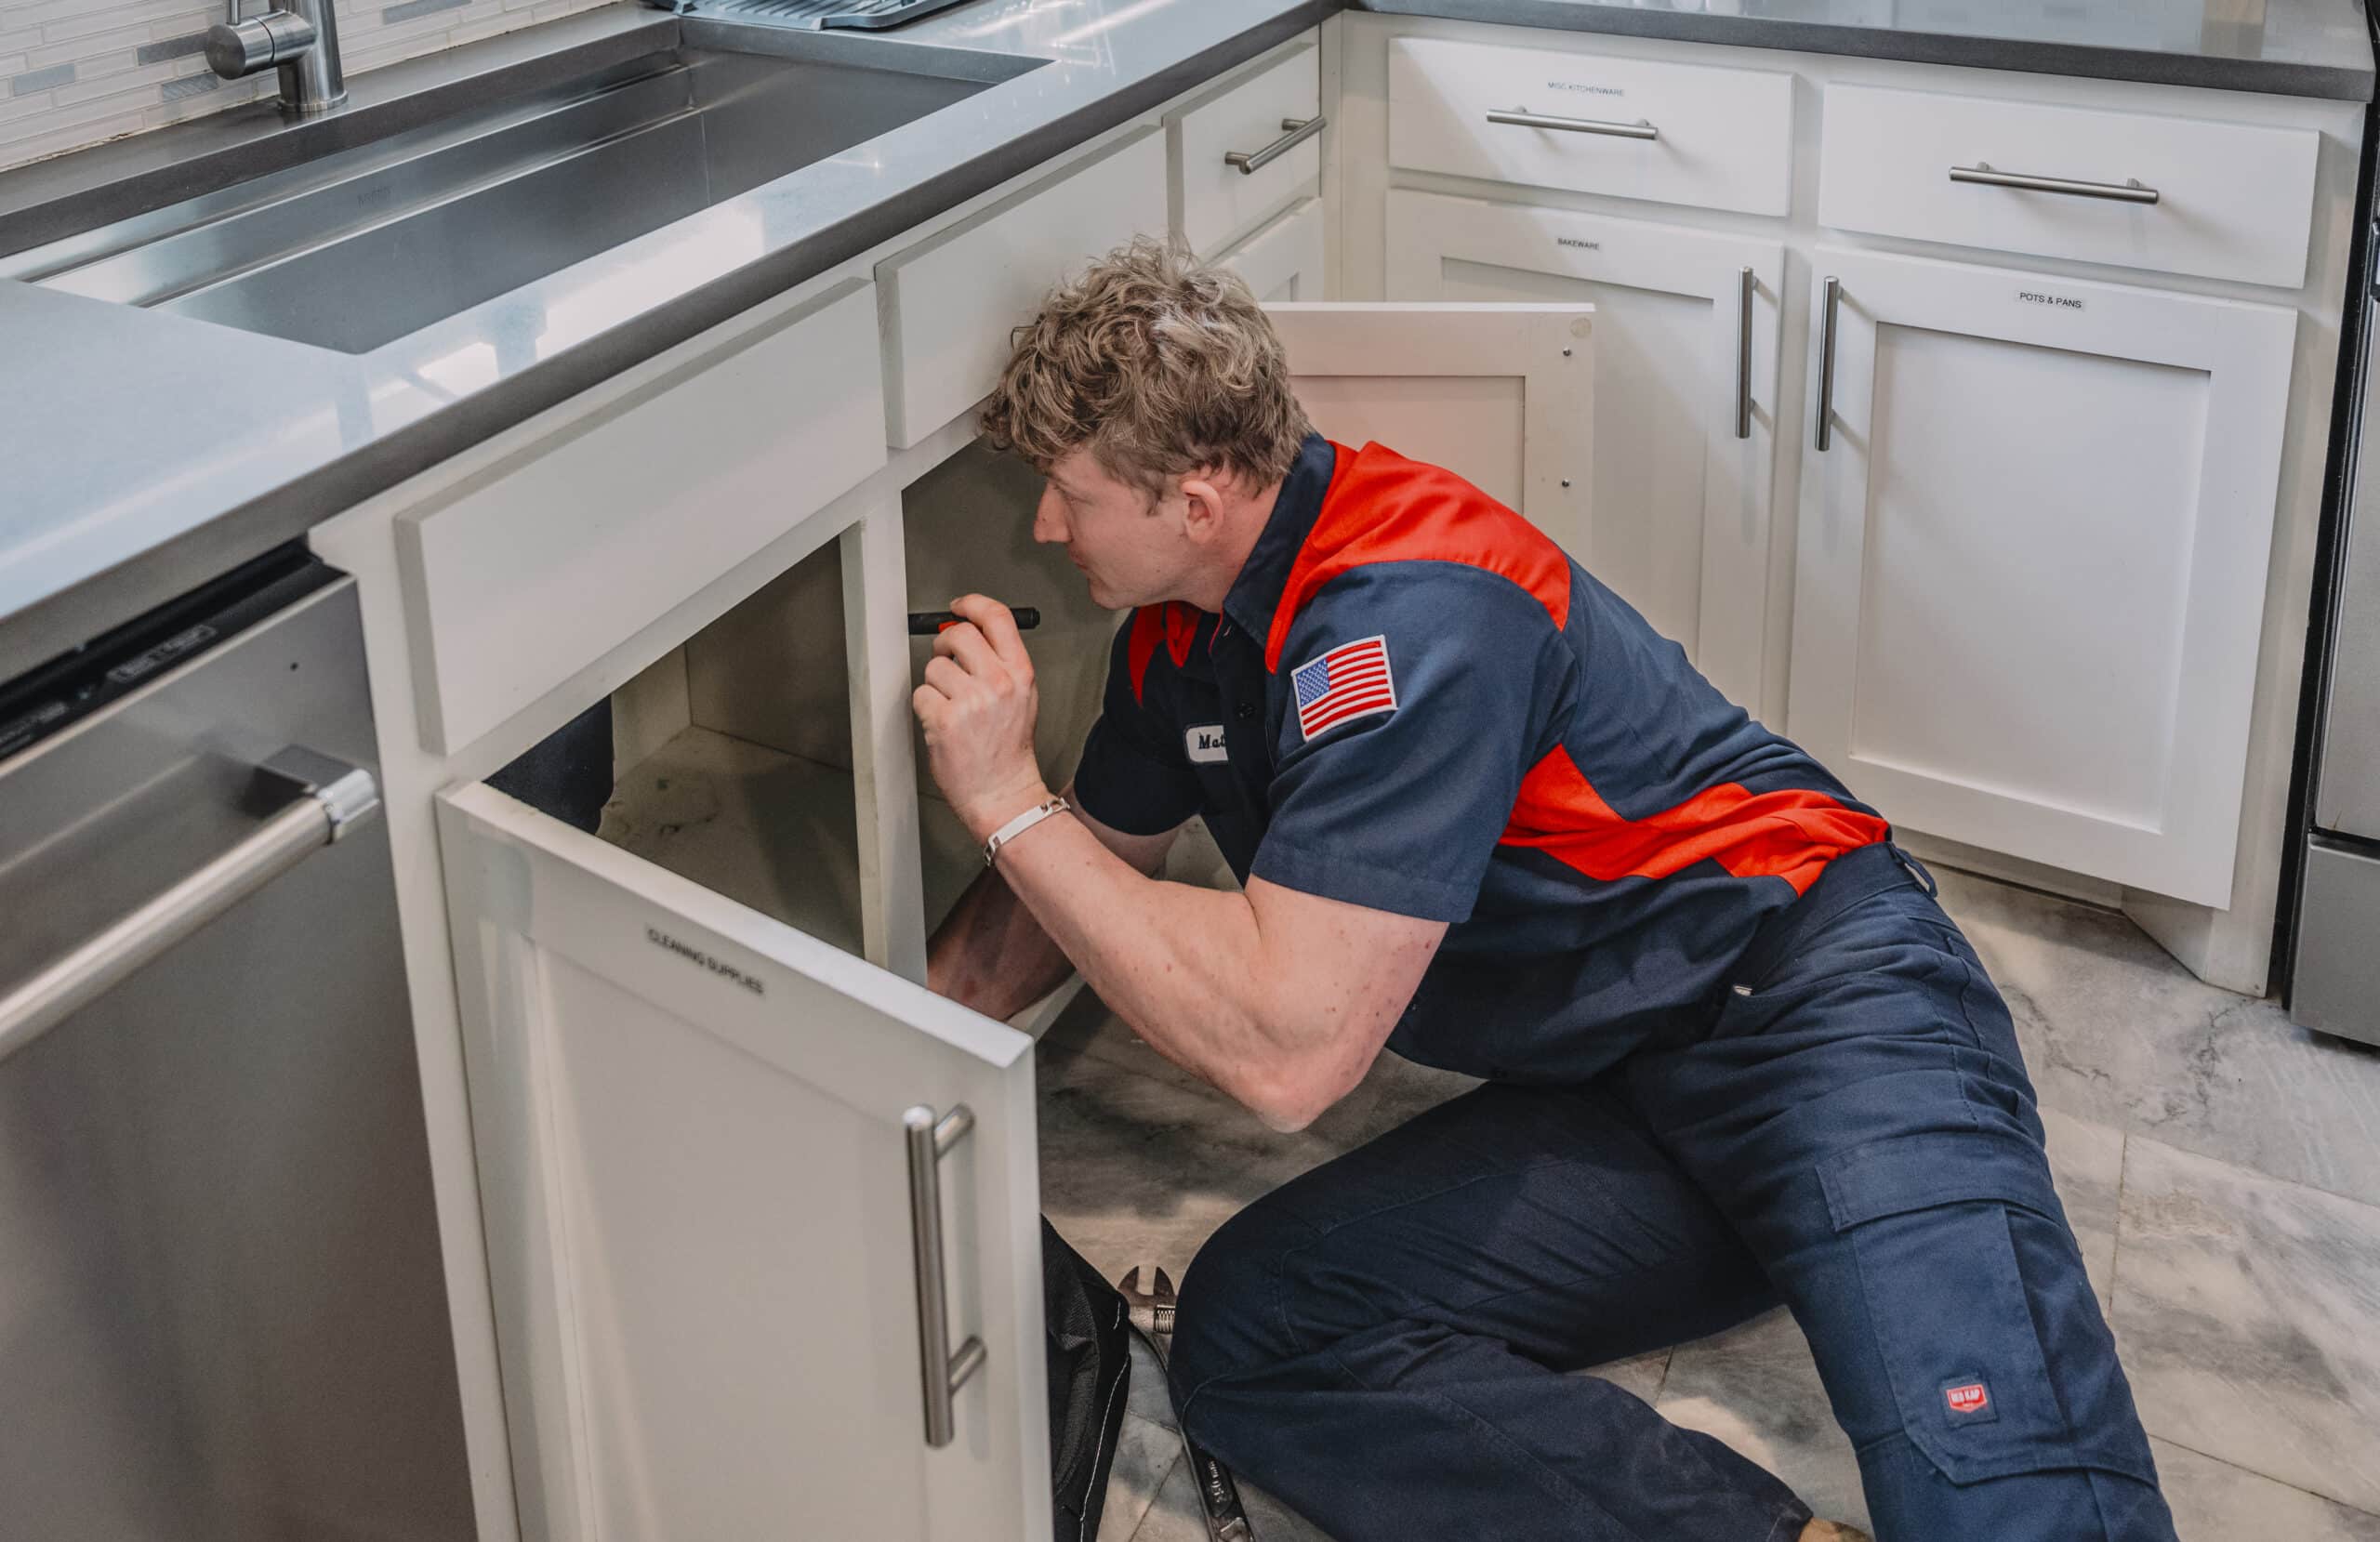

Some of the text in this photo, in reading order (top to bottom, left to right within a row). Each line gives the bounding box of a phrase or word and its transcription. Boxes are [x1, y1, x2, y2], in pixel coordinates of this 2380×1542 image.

[1568, 84, 1623, 97] KITCHENWARE
[1557, 238, 1599, 250] BAKEWARE
[2019, 292, 2082, 309] POTS & PANS
[648, 929, 764, 995] CLEANING SUPPLIES
[1964, 1389, 1979, 1400] KAP
